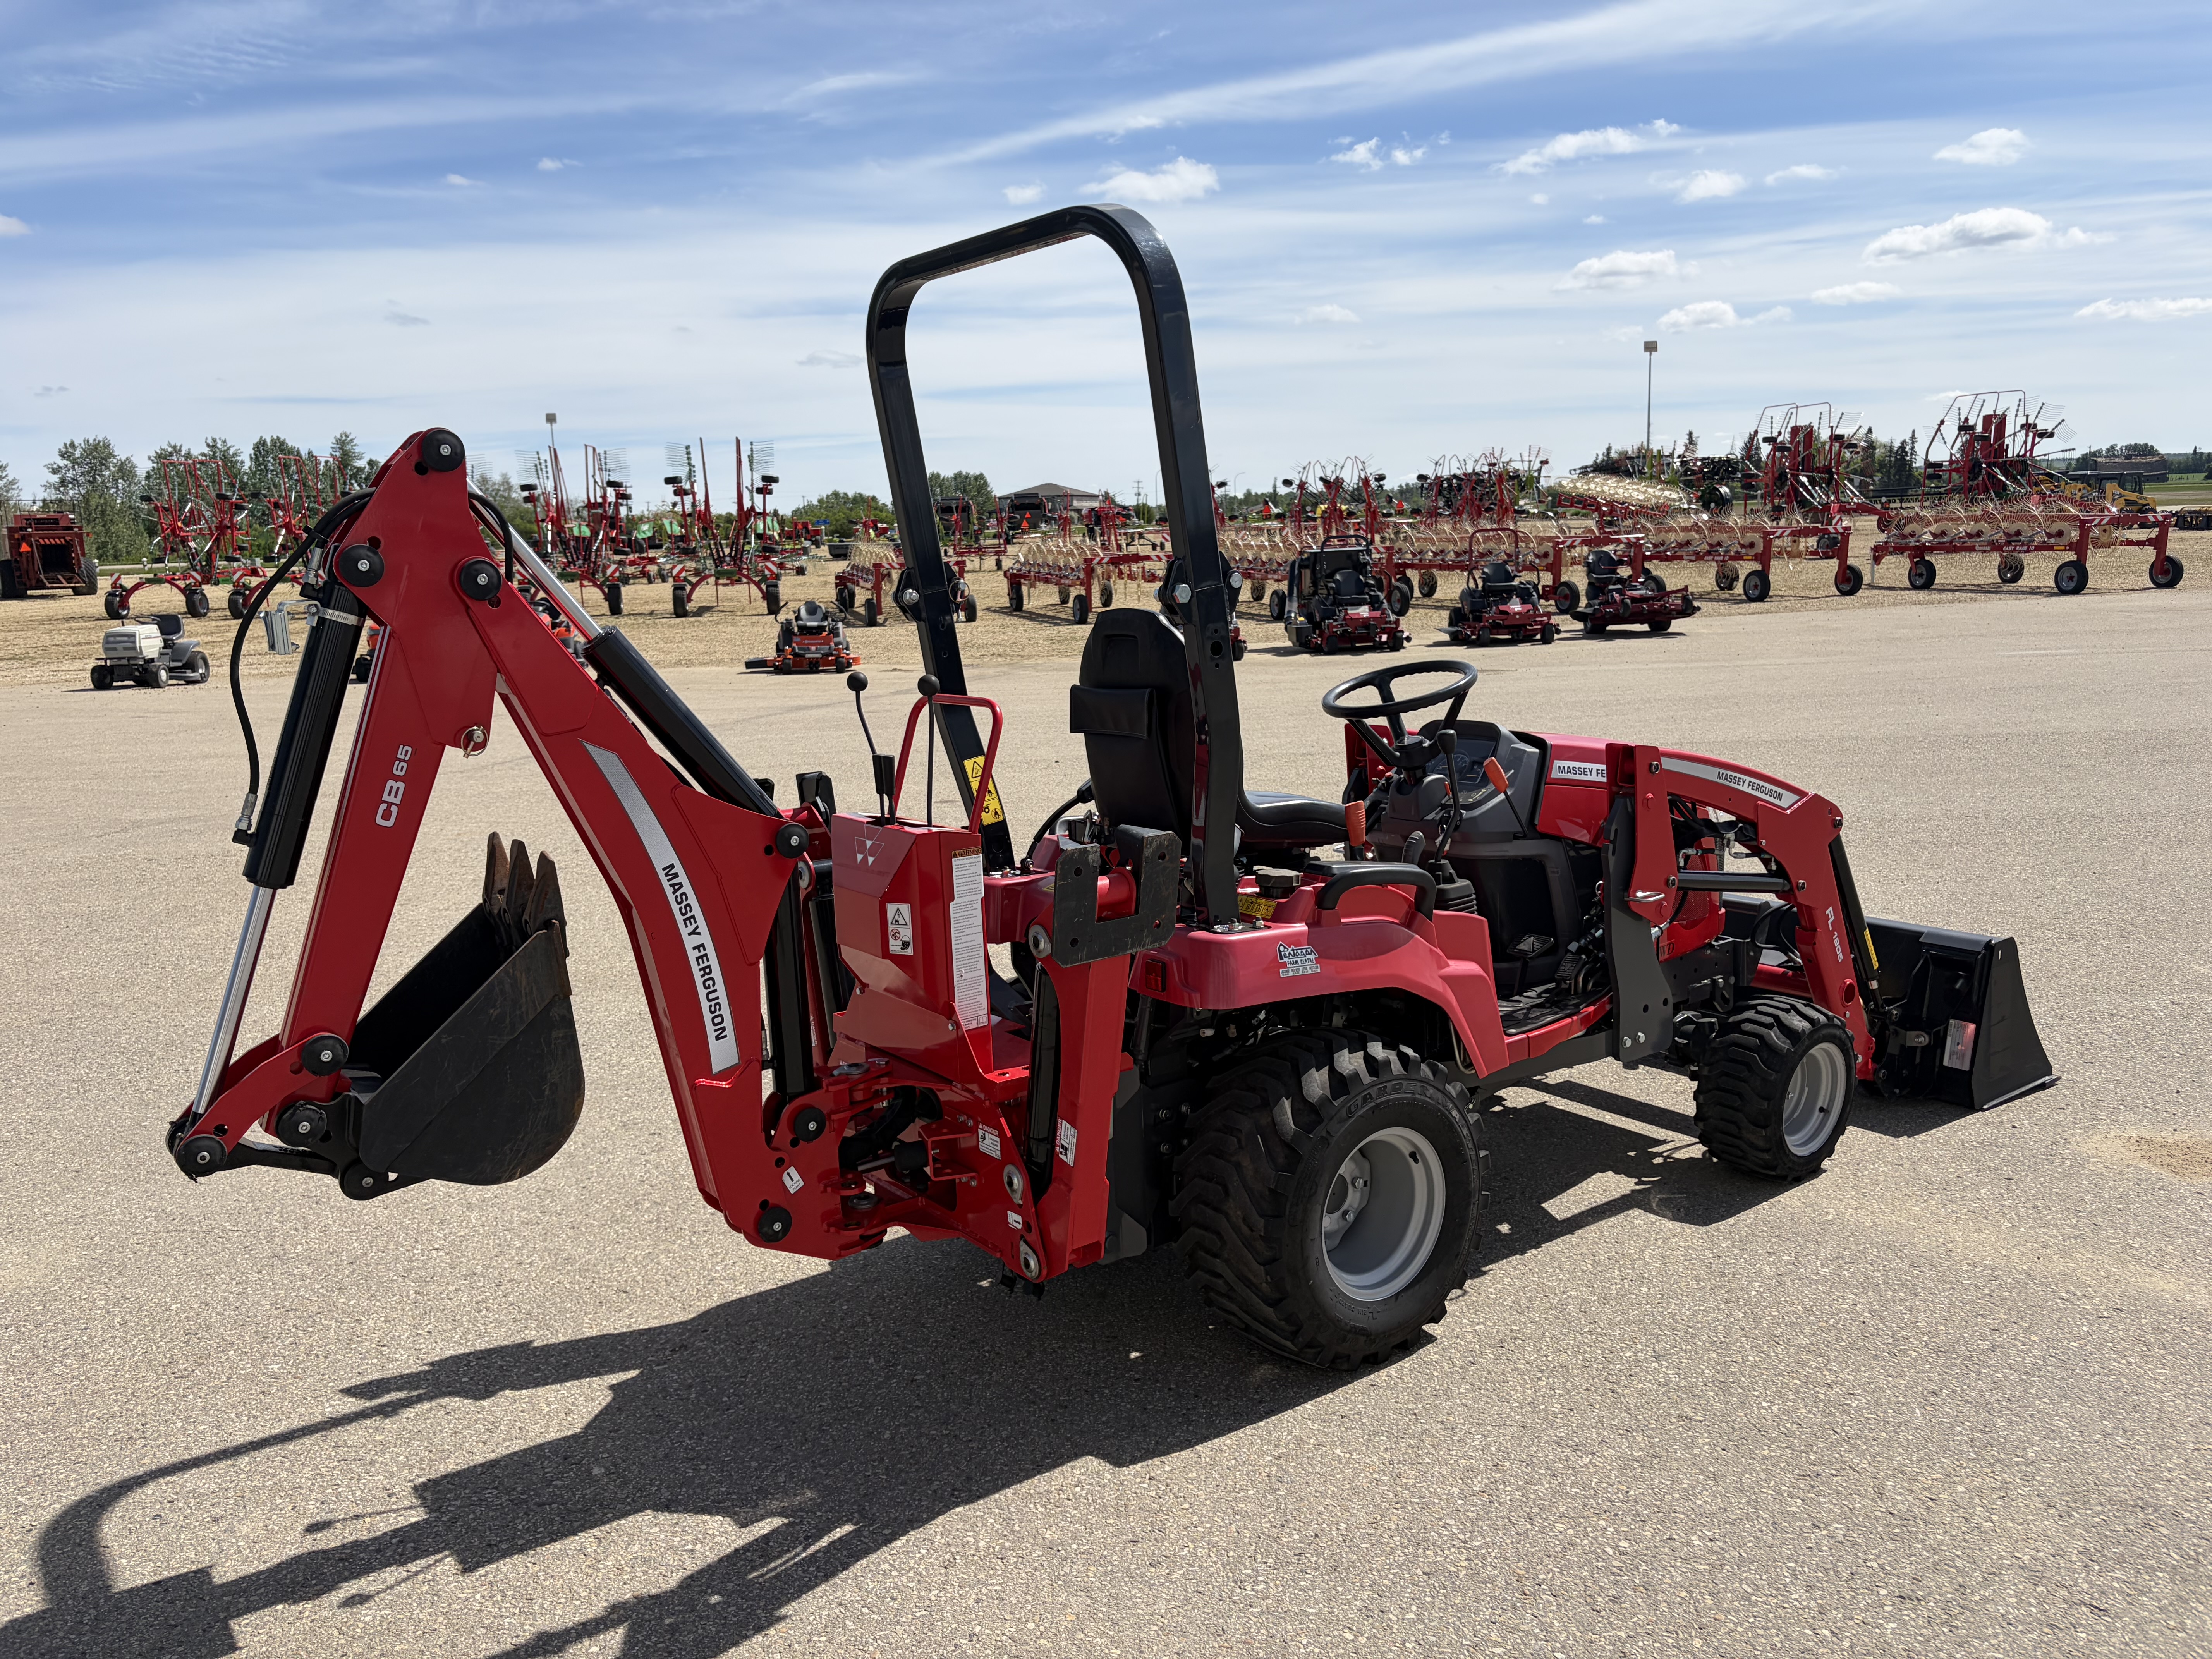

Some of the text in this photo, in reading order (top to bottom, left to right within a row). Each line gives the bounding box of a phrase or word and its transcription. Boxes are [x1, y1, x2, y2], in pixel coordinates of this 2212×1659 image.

[1558, 765, 1593, 777] MASSEY
[376, 744, 412, 827] CB 65
[1717, 771, 1783, 802] MASSEY FERGUSON
[957, 847, 982, 857] WARNING
[1826, 906, 1835, 931] FL
[661, 862, 728, 1042] MASSEY FERGUSON
[983, 1125, 999, 1136] DANGER
